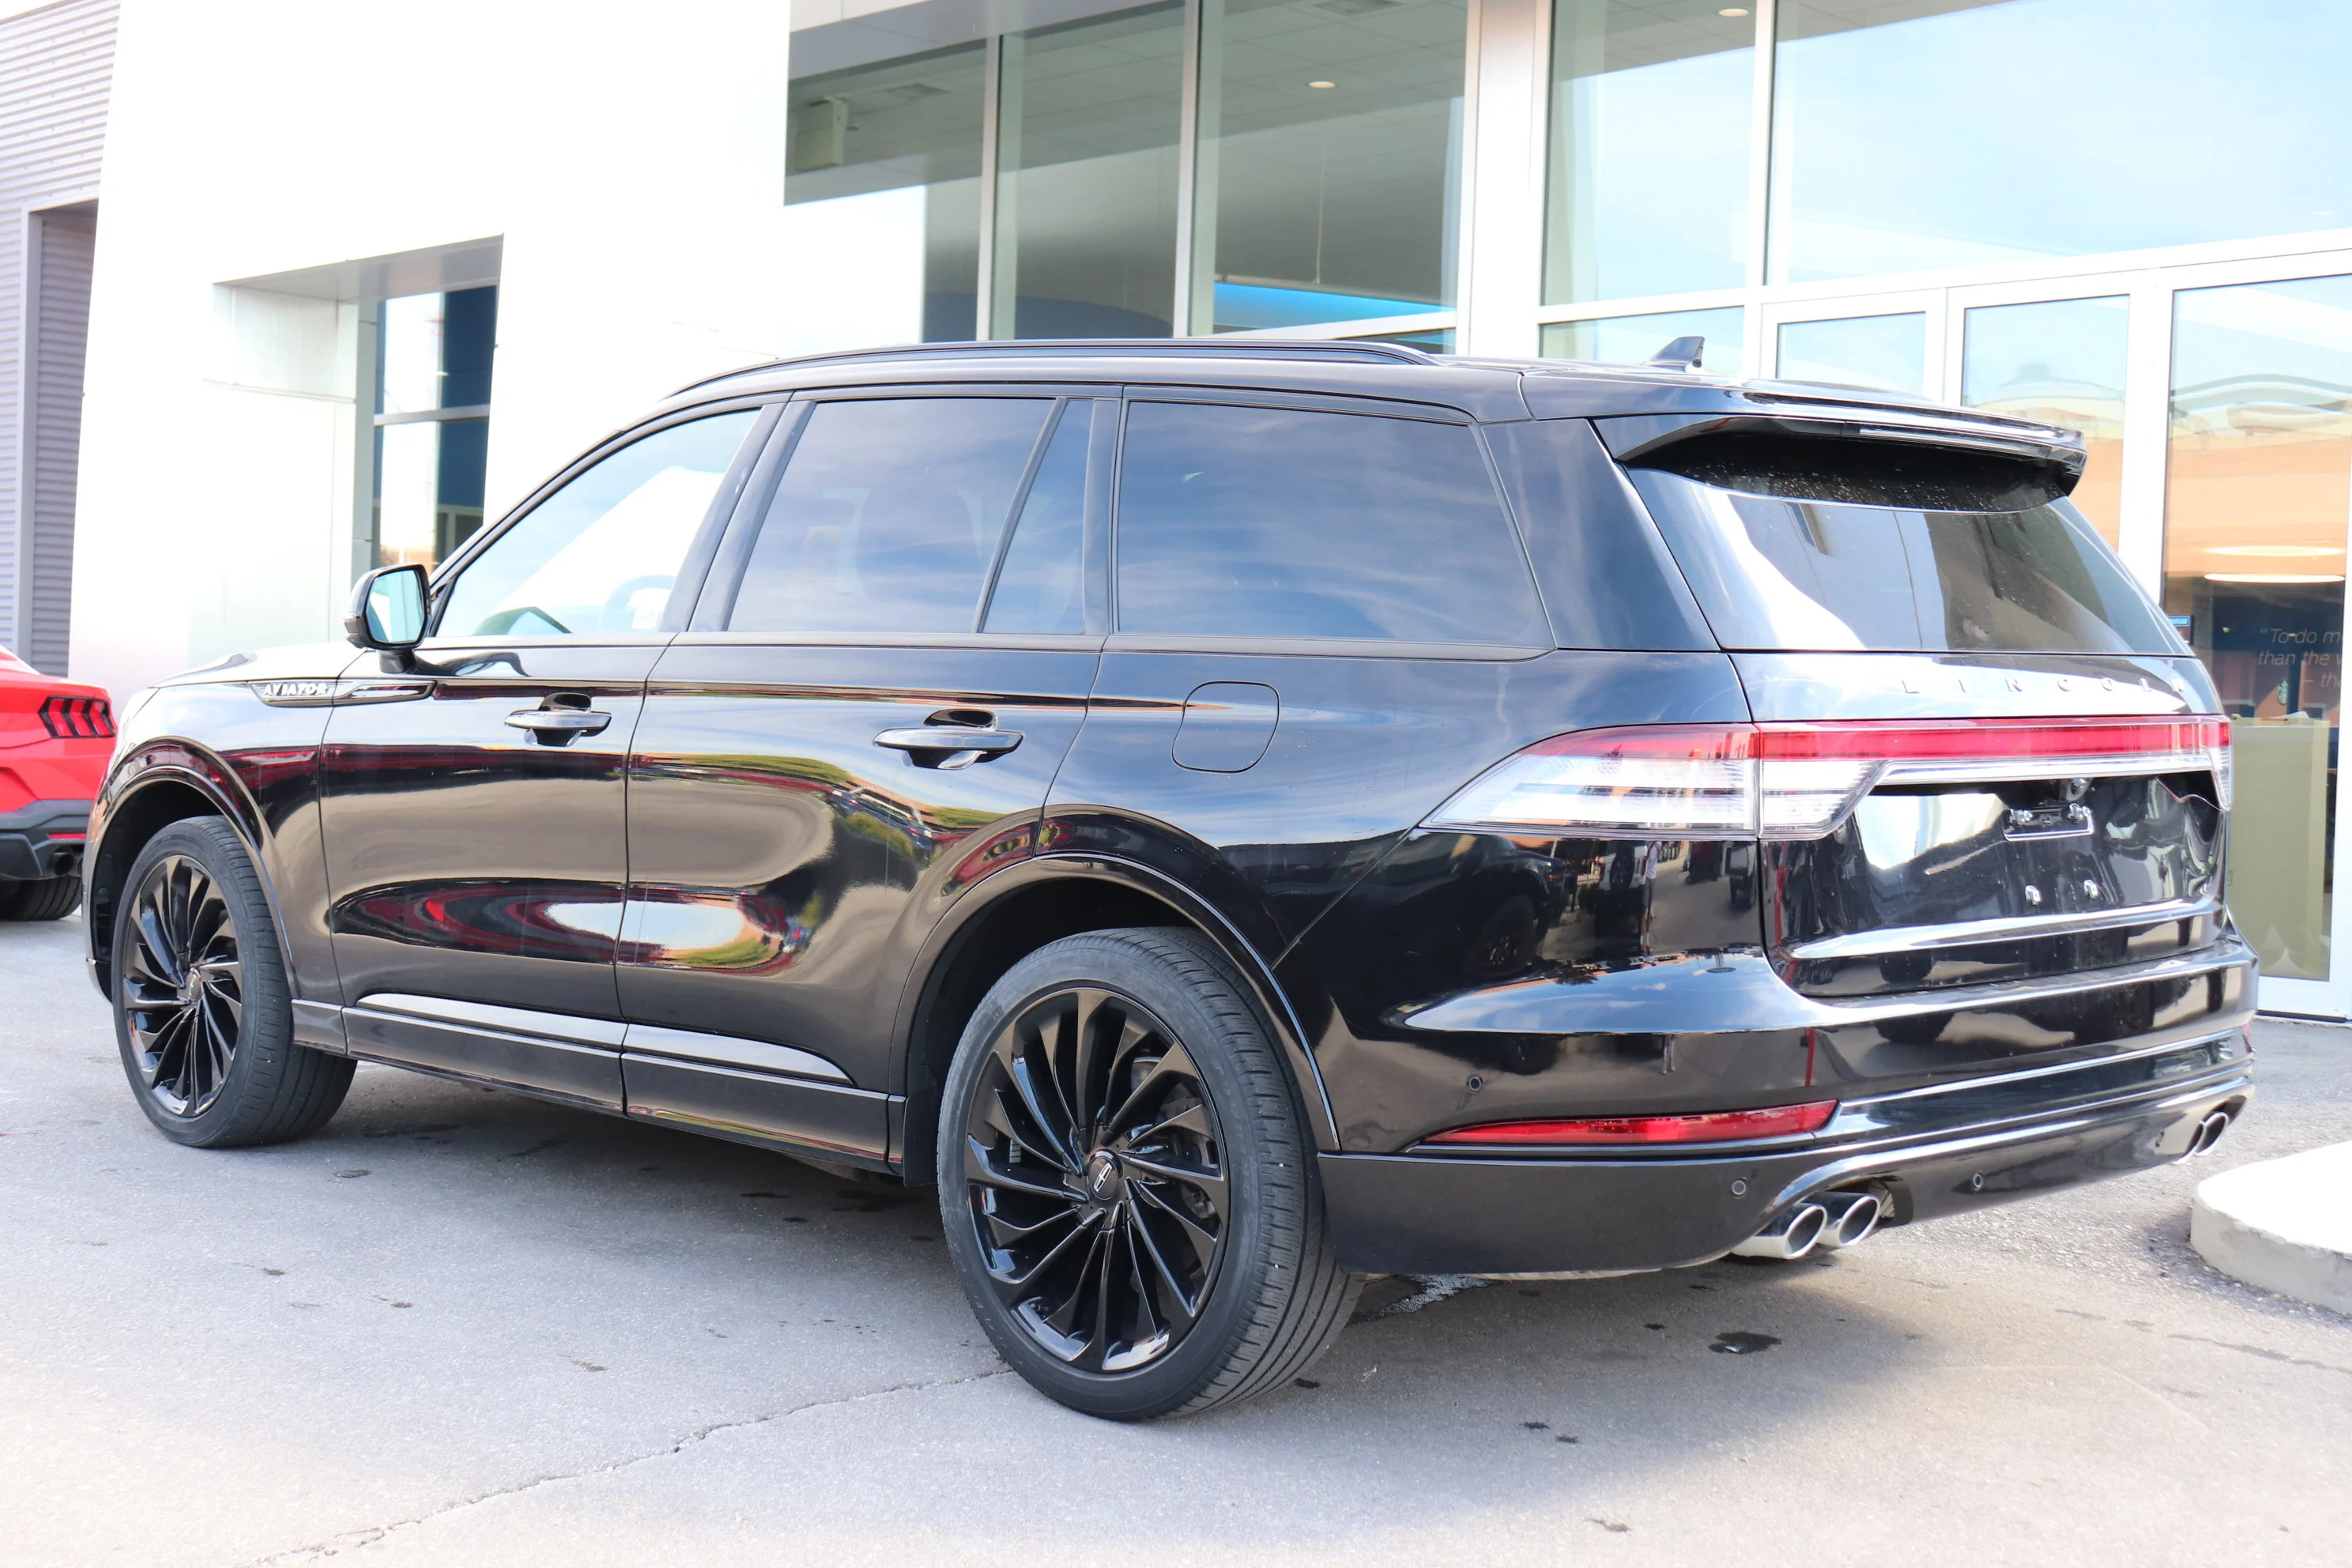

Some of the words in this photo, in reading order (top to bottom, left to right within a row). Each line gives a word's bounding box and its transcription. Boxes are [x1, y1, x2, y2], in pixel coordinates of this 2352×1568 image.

[2295, 628, 2317, 644] do
[2258, 650, 2296, 665] than
[2303, 650, 2330, 665] the
[264, 683, 330, 696] AVIATOR
[1902, 677, 2185, 694] LINCOLN
